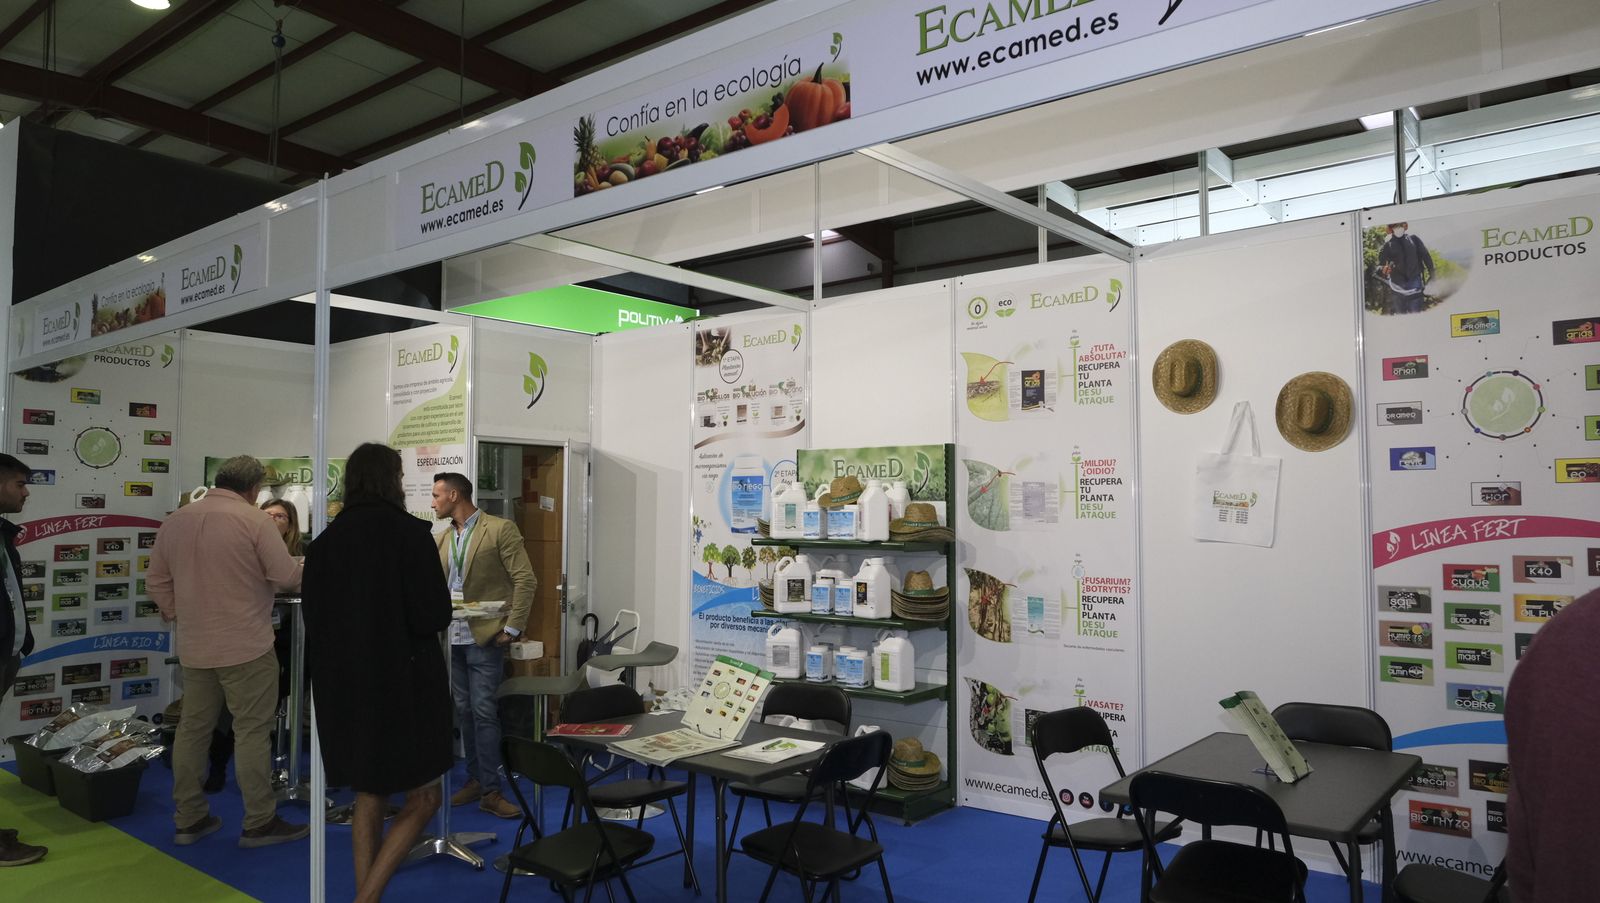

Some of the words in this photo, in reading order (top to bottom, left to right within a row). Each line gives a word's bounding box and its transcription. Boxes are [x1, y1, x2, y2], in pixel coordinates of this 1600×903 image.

[916, 11, 1120, 86] www.ecamed.es
[606, 103, 660, 137] Confía
[664, 96, 687, 119] en
[692, 89, 709, 110] la
[713, 54, 802, 102] ecología
[421, 199, 504, 234] www.ecamed.es
[1484, 242, 1586, 265] PRODUCTOS
[181, 284, 225, 304] www.ecamed.es
[998, 299, 1012, 307] eco
[1089, 343, 1115, 356] ¿TUTA
[94, 354, 151, 367] PRODUCTOS
[1078, 351, 1127, 363] ABSOLUTA?
[1078, 361, 1120, 372] RECUPERA
[1078, 380, 1112, 389] PLANTA
[1078, 388, 1089, 397] DE
[1091, 387, 1102, 396] SU
[1078, 396, 1114, 406] ATAQUE
[416, 455, 464, 467] ESPECIALIZACIÓN
[1081, 459, 1116, 470] ¿MILDIU?
[1083, 467, 1115, 477] ¿OIDIO?
[1080, 478, 1123, 487] RECUPERA
[1080, 486, 1090, 494] TU
[1080, 494, 1114, 502] PLANTA
[1080, 503, 1092, 511] DE
[1093, 503, 1103, 511] SU
[34, 520, 72, 537] LINEA
[75, 515, 108, 531] FERT
[1411, 523, 1467, 551] LINEA
[1470, 518, 1527, 540] FERT
[1529, 567, 1553, 576] K40
[1082, 577, 1131, 587] ¿FUSARIUM?
[1082, 585, 1131, 595] ¿BOTRYTIS?
[1082, 595, 1124, 605] RECUPERA
[1082, 604, 1092, 612] TU
[706, 614, 732, 622] producto
[732, 615, 759, 625] beneficia
[1082, 612, 1116, 621] PLANTA
[720, 622, 746, 632] diversos
[1082, 620, 1094, 629] DE
[1095, 621, 1105, 629] SU
[1082, 629, 1118, 639] ATAQUE
[94, 636, 129, 649] LINEA
[1417, 776, 1456, 788] secano
[1410, 812, 1429, 823] BIO
[1488, 814, 1504, 823] BIO
